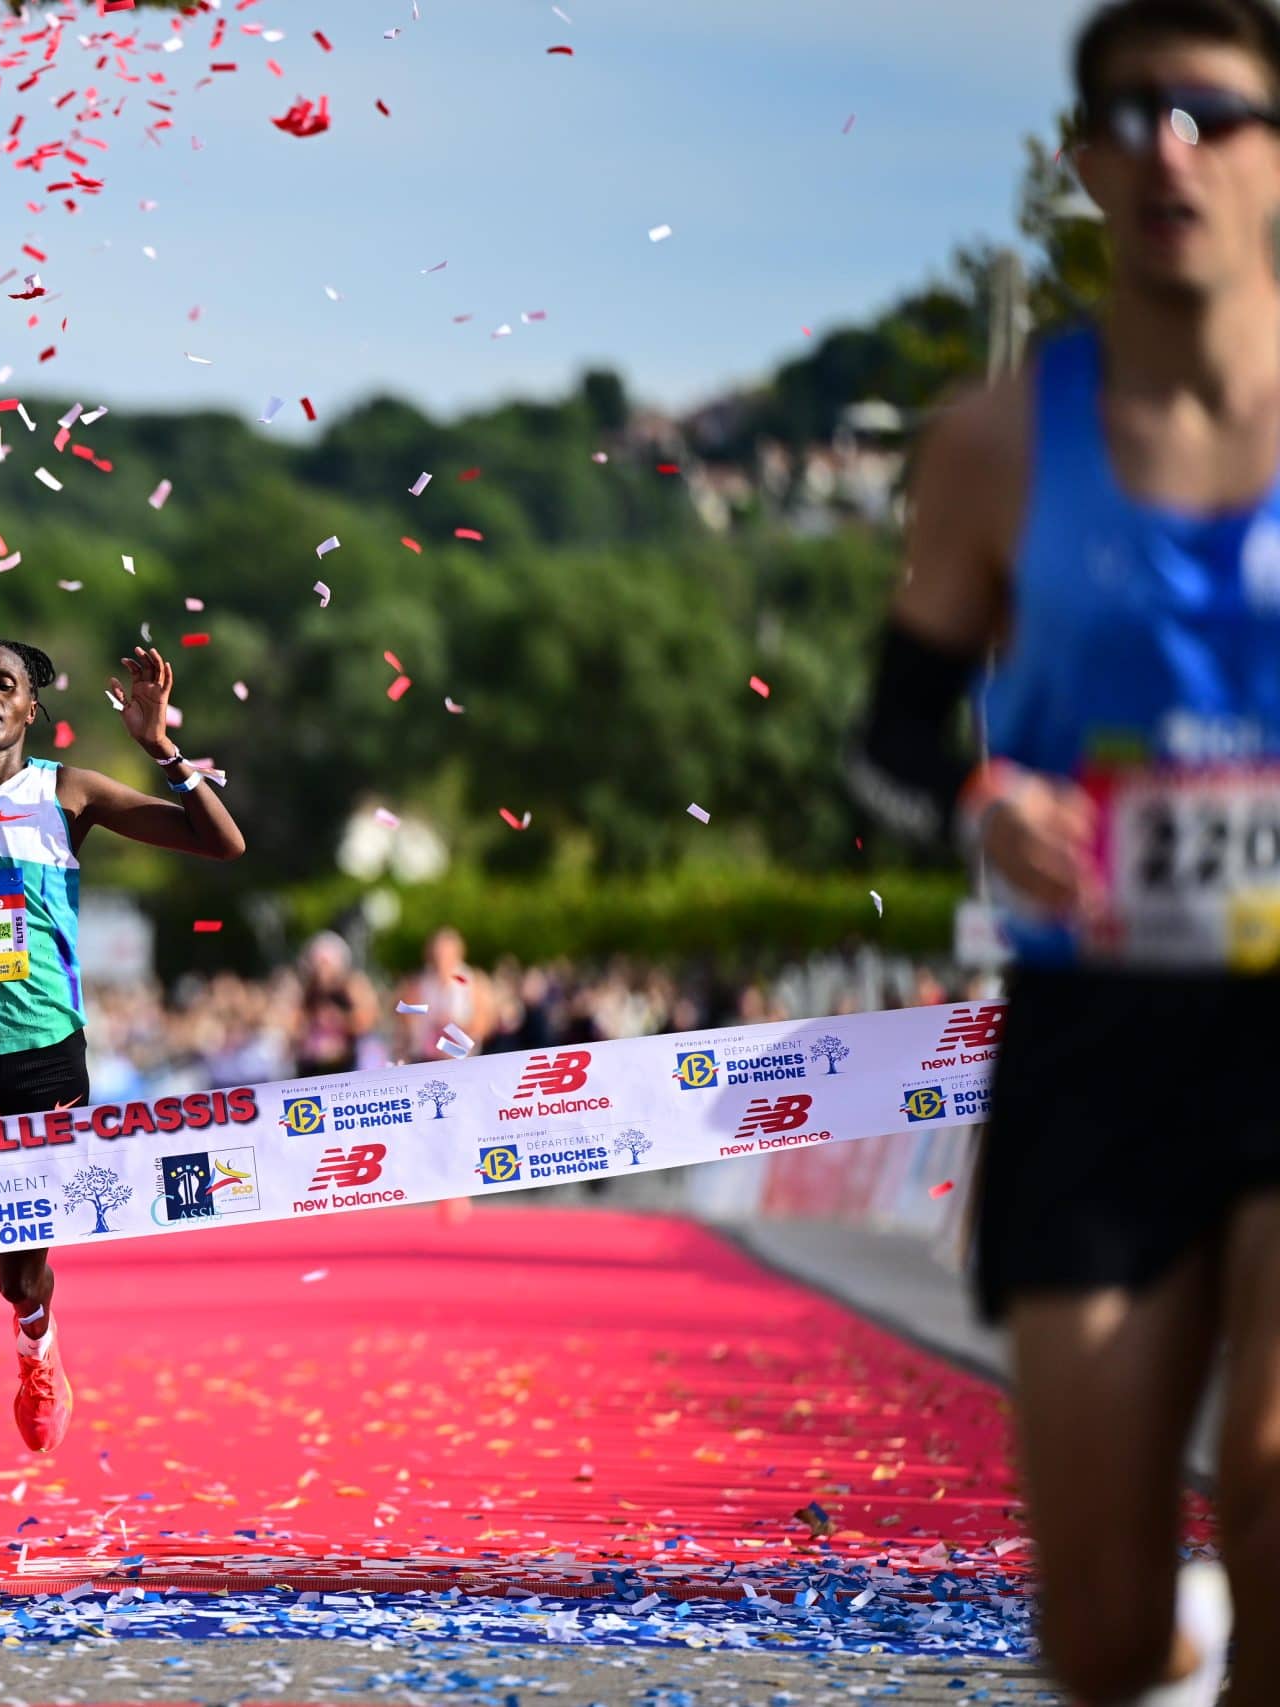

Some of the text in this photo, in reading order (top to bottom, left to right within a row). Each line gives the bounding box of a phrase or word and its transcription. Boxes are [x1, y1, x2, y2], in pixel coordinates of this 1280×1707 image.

[15, 916, 24, 944] ELITES
[724, 1040, 802, 1056] DÉPARTEMENT
[921, 1057, 956, 1071] new
[331, 1084, 409, 1102] DÉPARTEMENT
[499, 1105, 534, 1121] new
[526, 1133, 605, 1151] DÉPARTEMENT
[720, 1141, 755, 1157] new
[150, 1194, 224, 1227] CASSIS
[293, 1198, 328, 1213] new
